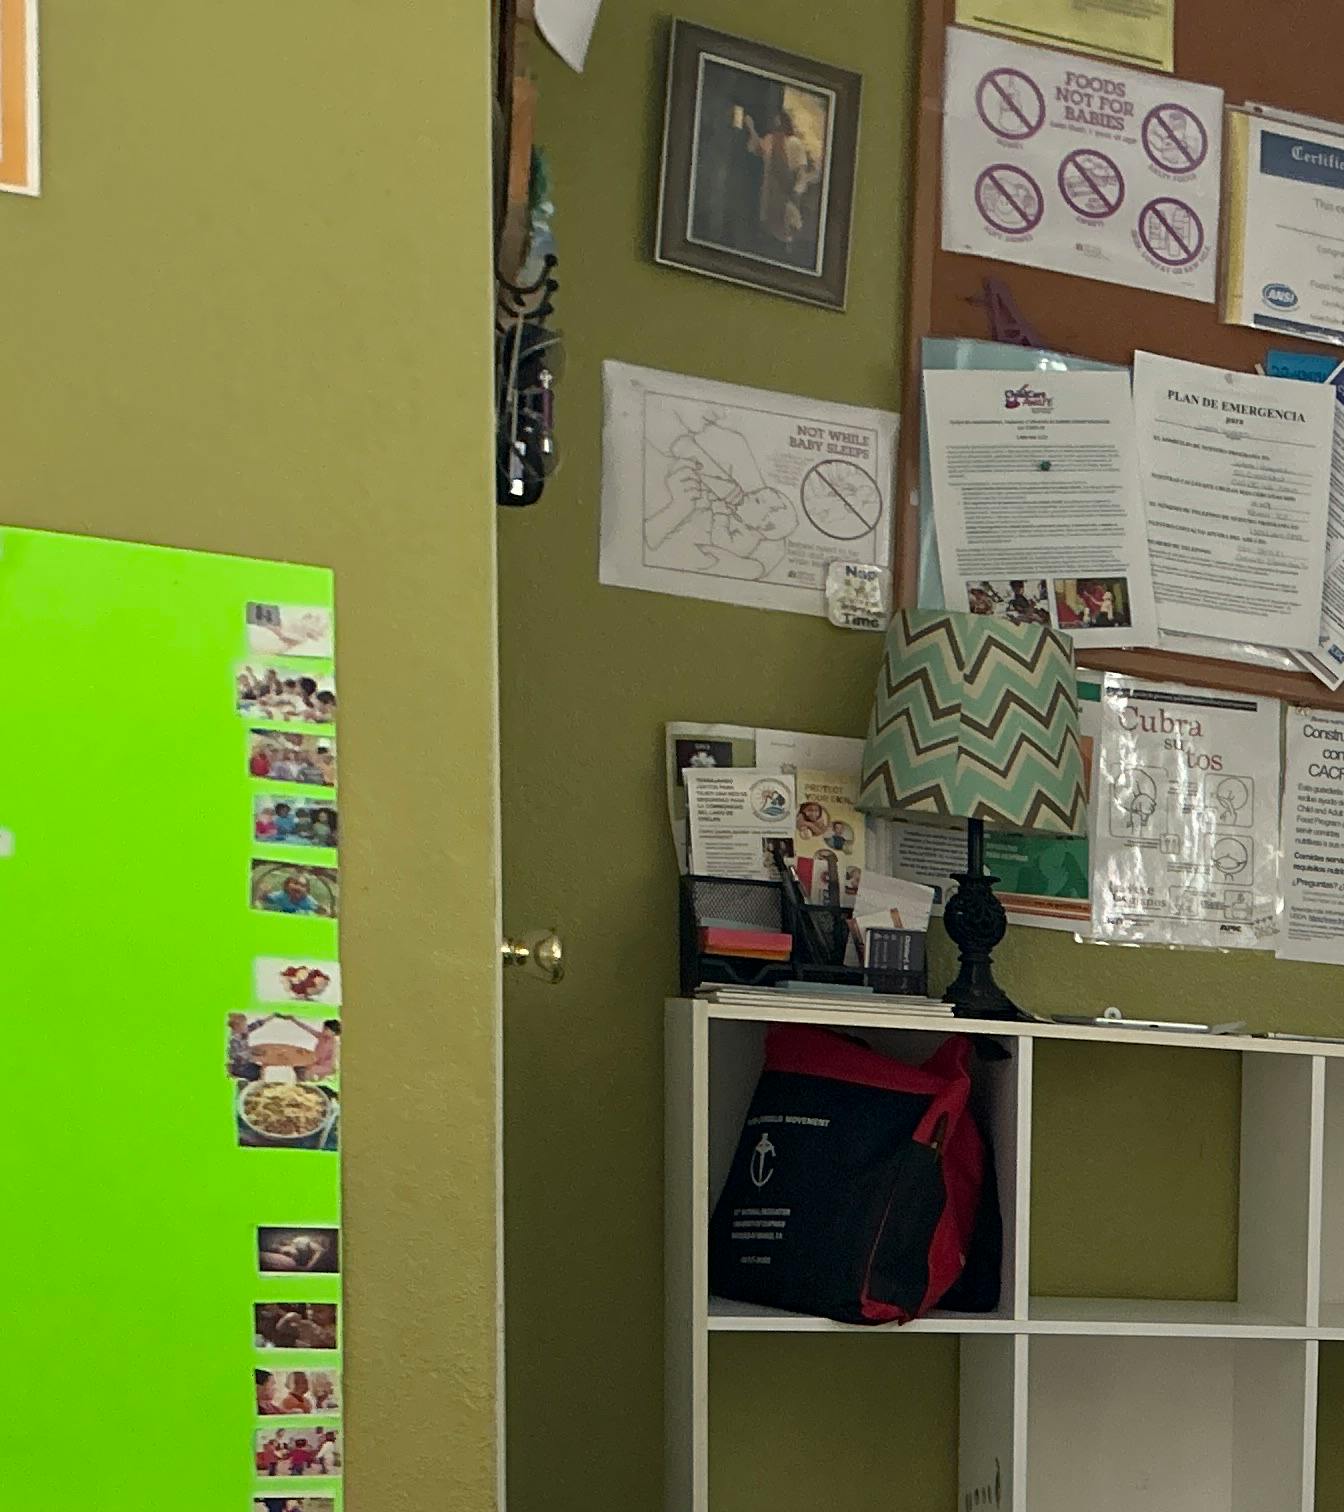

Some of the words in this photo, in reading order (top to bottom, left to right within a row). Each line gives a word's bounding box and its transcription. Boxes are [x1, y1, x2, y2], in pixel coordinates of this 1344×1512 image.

[1065, 71, 1126, 98] FOODS
[1055, 86, 1093, 106] NOT
[1099, 97, 1135, 118] FOR
[1064, 105, 1125, 131] BABIES
[1313, 198, 1334, 212] This
[1167, 389, 1200, 406] PLAN
[1202, 396, 1219, 411] DE
[1221, 401, 1306, 424] EMERGENCIA
[789, 436, 824, 453] BABY
[827, 443, 870, 460] SLEEPS
[797, 425, 827, 440] NOT
[828, 430, 870, 448] WHILE
[844, 565, 878, 581] Nap
[843, 615, 880, 628] Time
[1118, 705, 1203, 737] Cubra
[1163, 737, 1185, 751] su
[1186, 751, 1224, 772] tos
